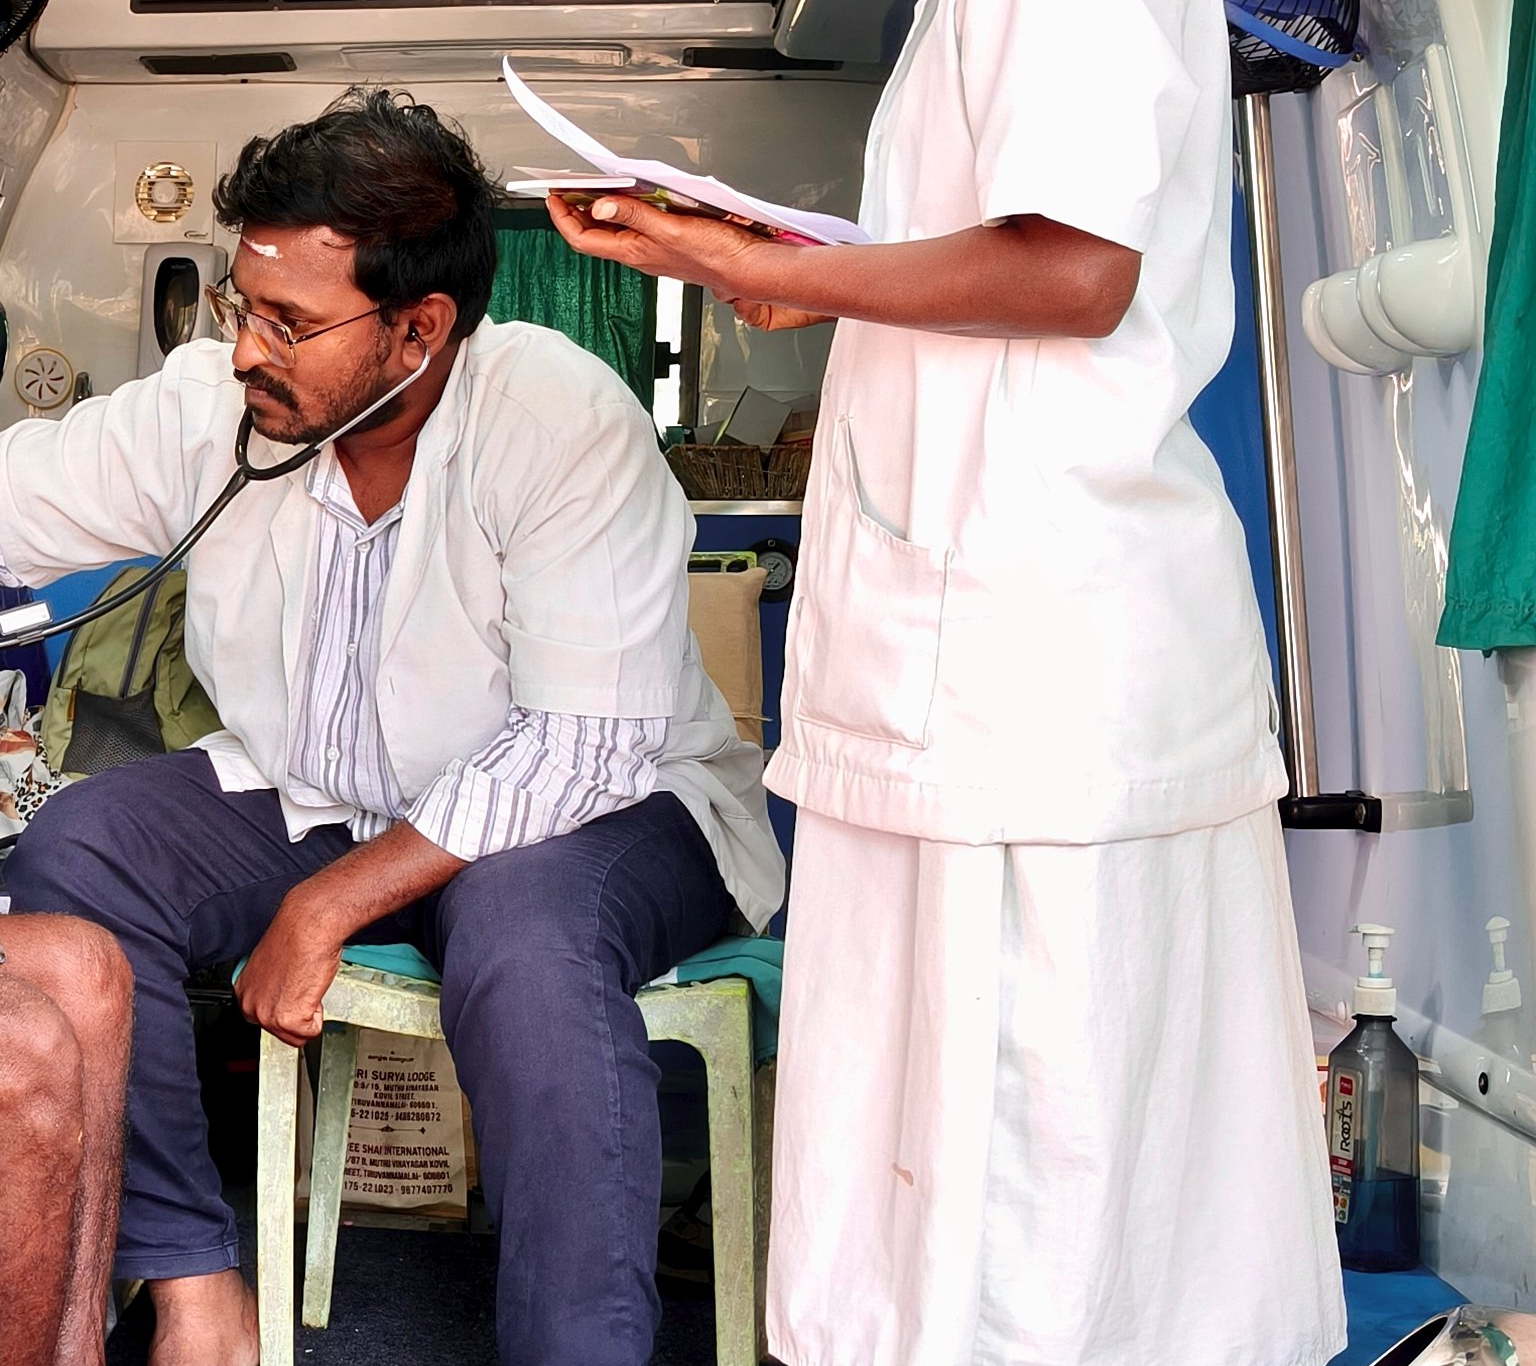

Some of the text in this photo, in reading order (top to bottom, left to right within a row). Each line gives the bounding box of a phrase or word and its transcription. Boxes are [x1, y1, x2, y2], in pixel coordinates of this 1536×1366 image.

[355, 1069, 436, 1082] RI SURYA LODGE
[348, 1142, 449, 1157] EE SHAI INTERNATIONAL
